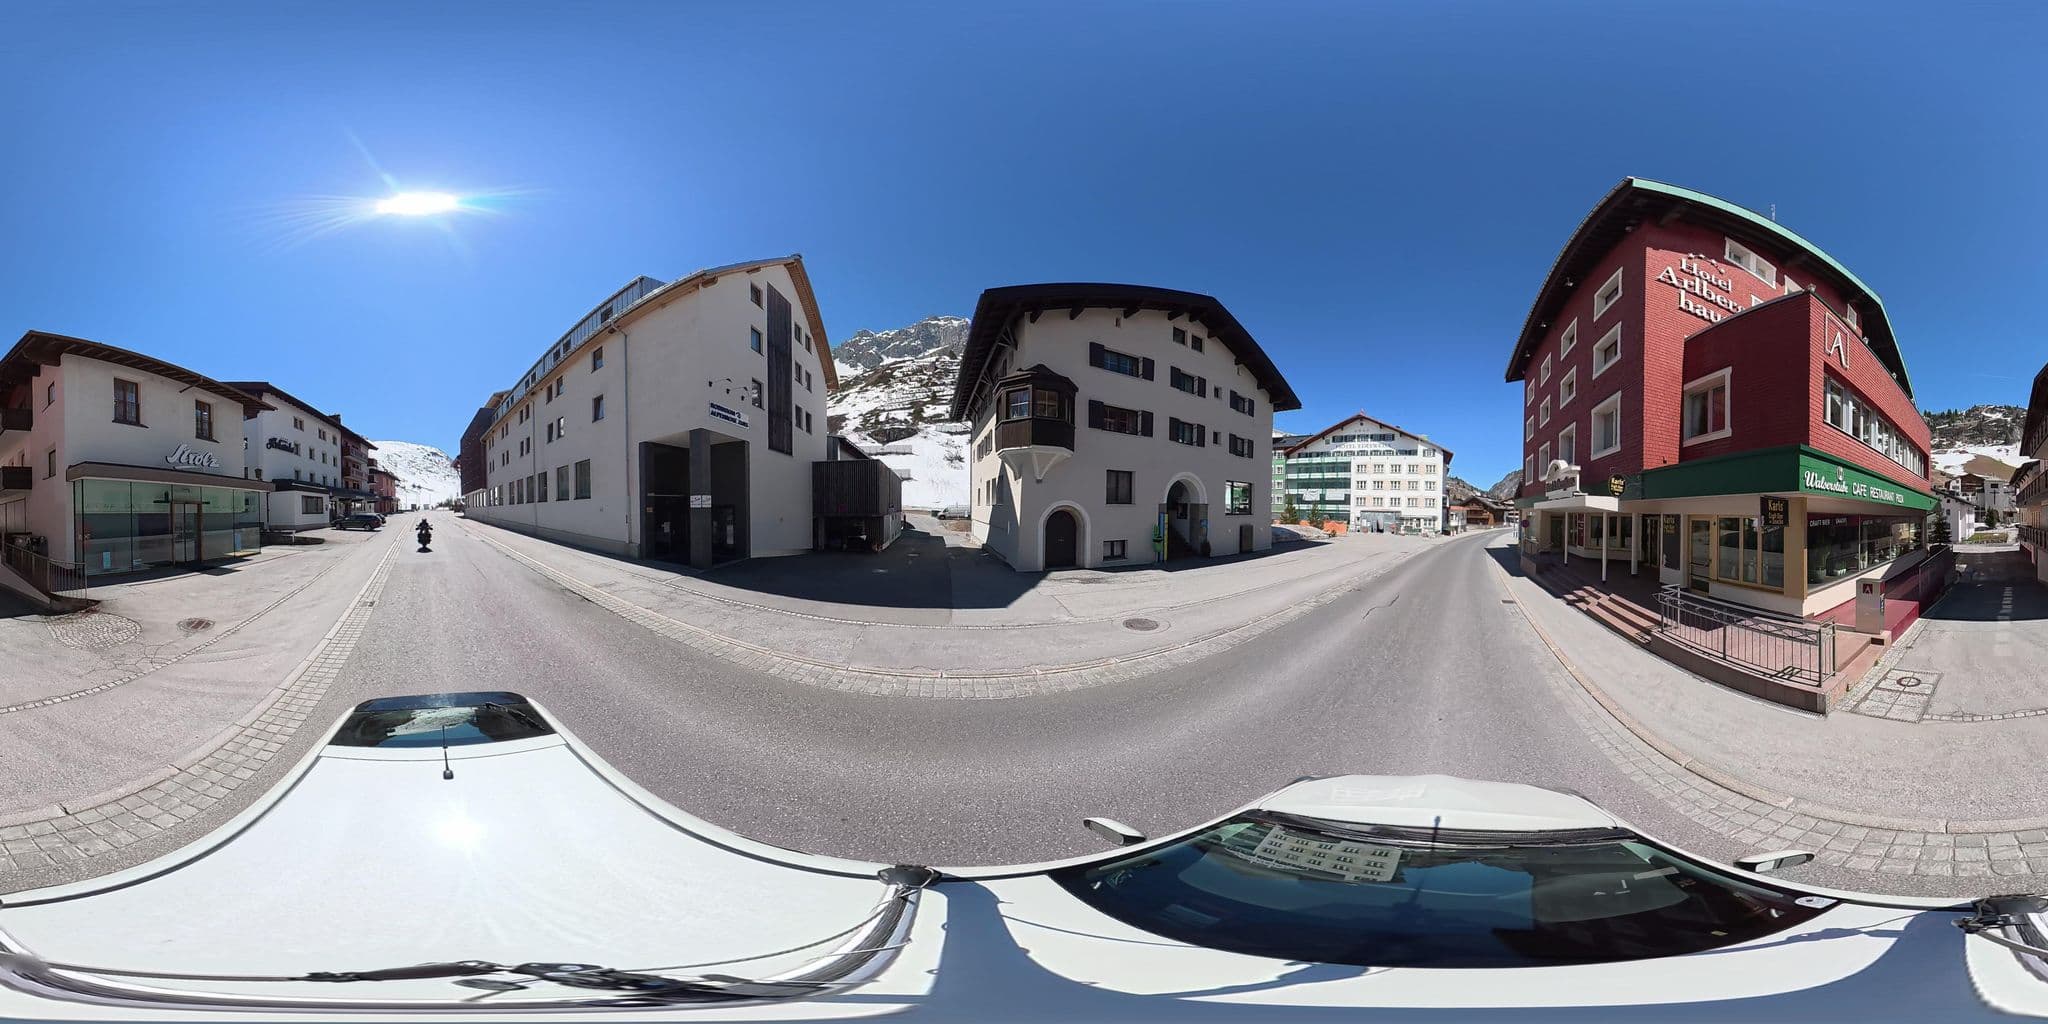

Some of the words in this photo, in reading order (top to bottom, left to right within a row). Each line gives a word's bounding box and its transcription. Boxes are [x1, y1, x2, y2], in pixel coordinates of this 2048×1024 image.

[1680, 257, 1732, 293] Hotel
[1679, 289, 1727, 323] hau
[166, 443, 220, 468] Strolz
